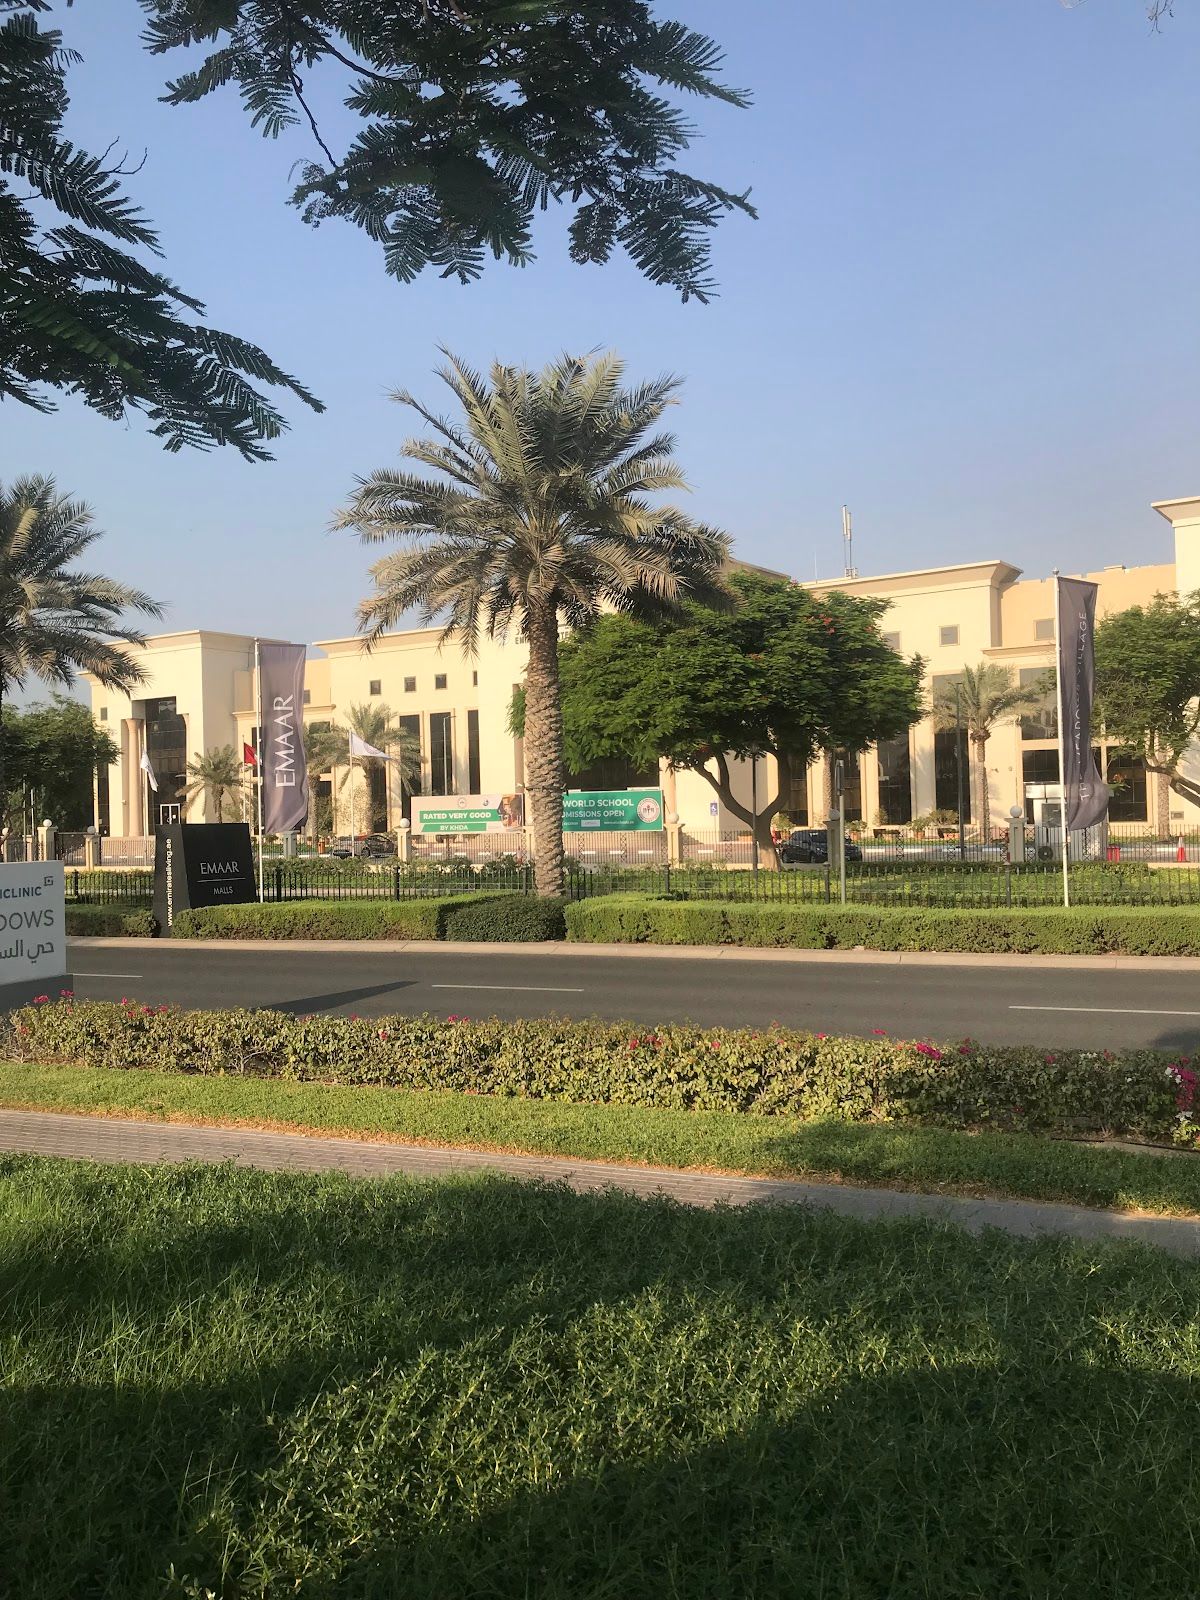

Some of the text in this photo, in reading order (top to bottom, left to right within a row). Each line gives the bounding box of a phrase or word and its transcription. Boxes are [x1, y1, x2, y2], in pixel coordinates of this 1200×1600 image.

[273, 694, 296, 788] EMAAR
[563, 798, 634, 808] WORLD SCHOOL
[423, 811, 491, 820] RATED VERY GOOD
[200, 861, 239, 875] EMAAR
[165, 838, 174, 927] www.emiratesliving.ae
[213, 886, 234, 895] MALLS
[27, 941, 55, 963] حي
